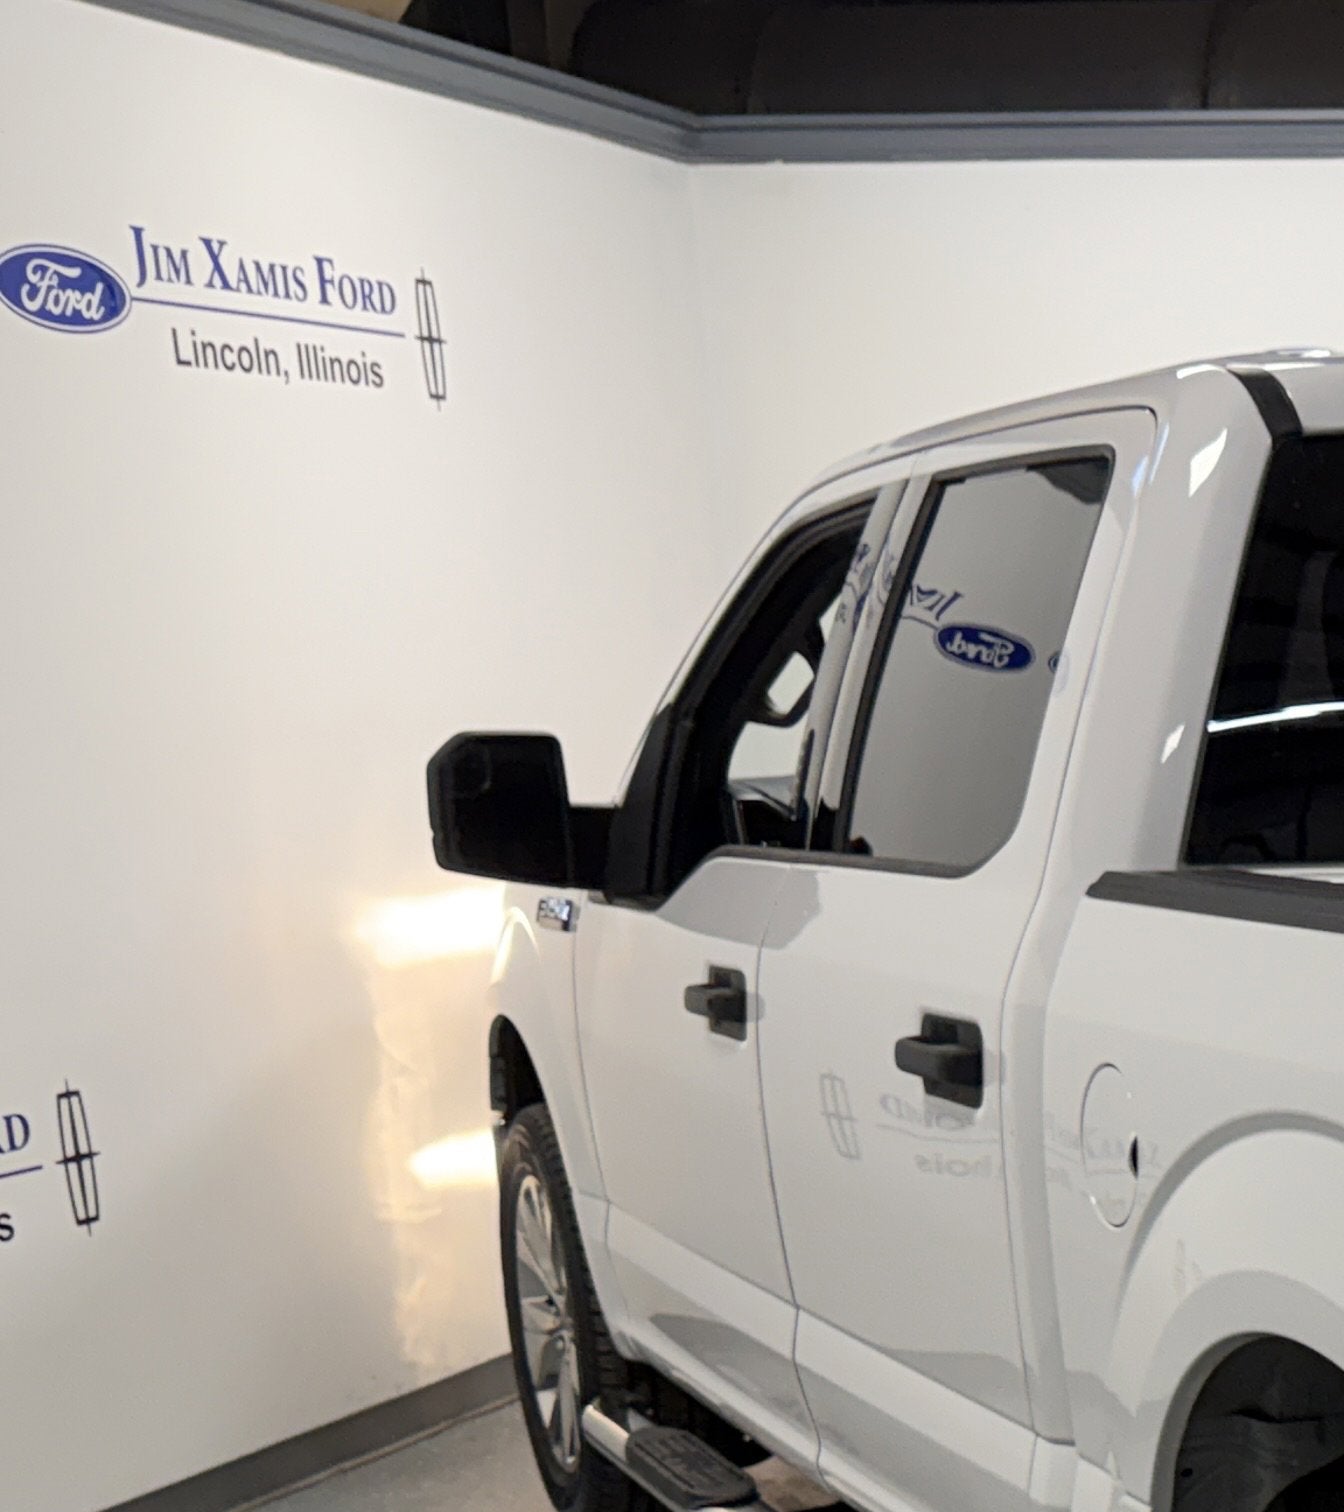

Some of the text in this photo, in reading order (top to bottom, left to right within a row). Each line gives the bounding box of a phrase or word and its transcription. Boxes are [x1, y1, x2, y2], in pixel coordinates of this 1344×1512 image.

[21, 257, 106, 321] Ford
[171, 326, 386, 389] Lincoln, Illinois
